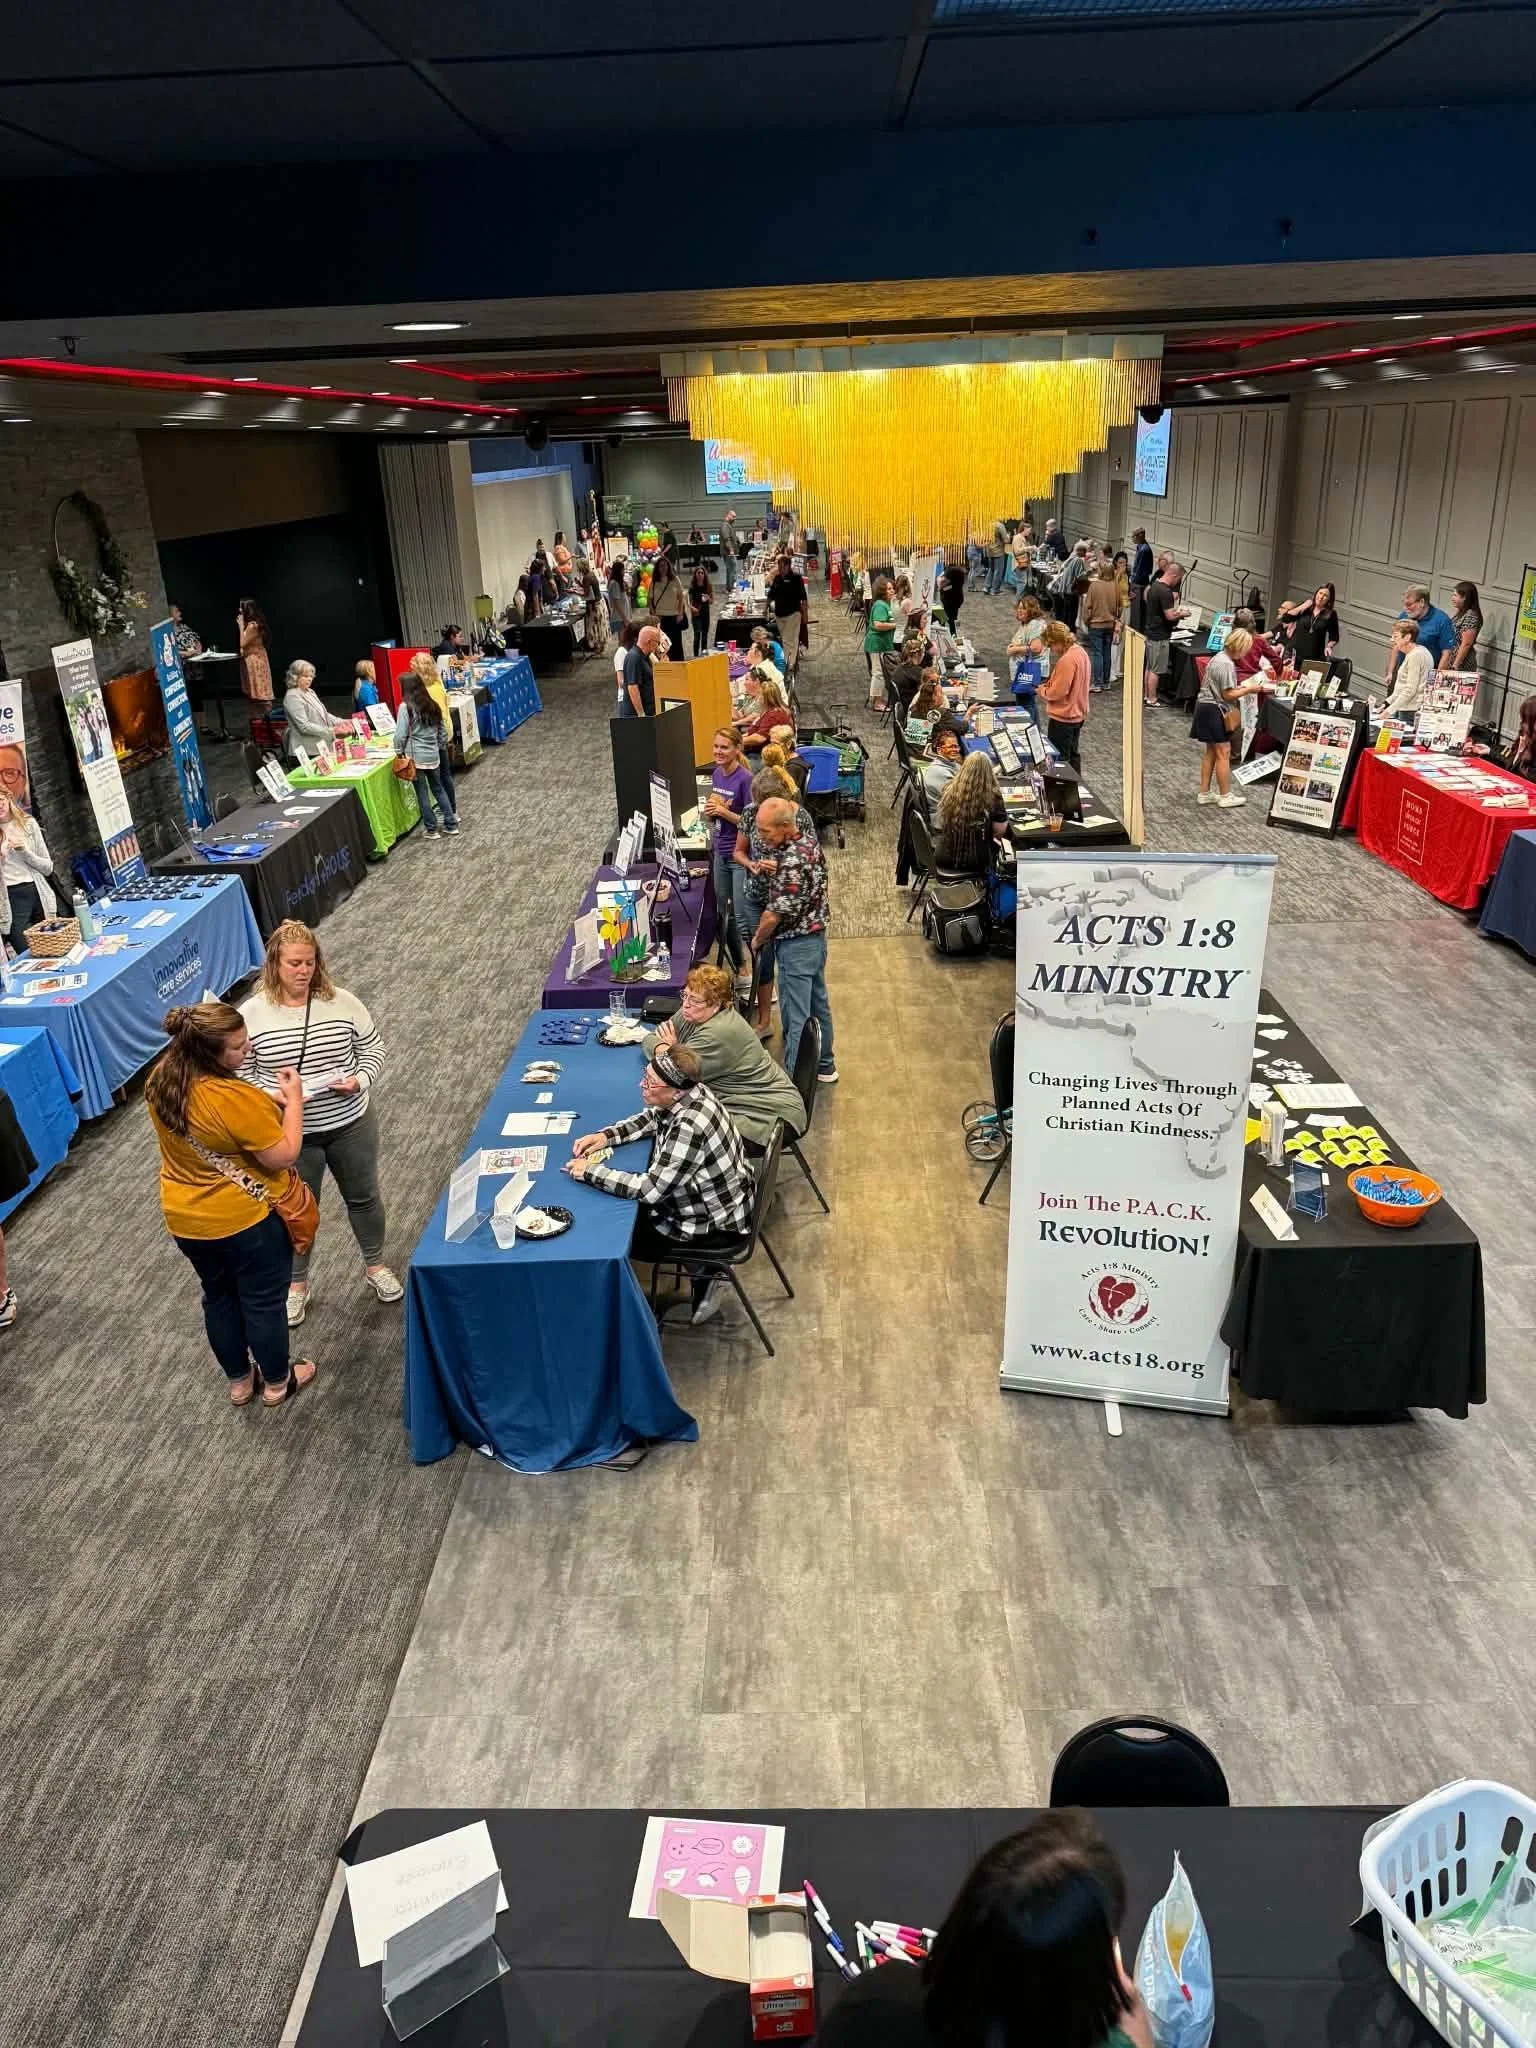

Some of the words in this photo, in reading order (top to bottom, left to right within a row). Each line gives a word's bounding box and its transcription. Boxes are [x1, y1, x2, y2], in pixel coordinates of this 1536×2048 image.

[1054, 914, 1168, 946] ACTS
[1177, 918, 1236, 949] 1:8
[153, 942, 199, 984] innovative
[158, 979, 175, 999] care
[175, 957, 202, 985] services
[1028, 963, 1244, 999] MINISTRY
[1028, 1071, 1110, 1092] Changing
[1114, 1076, 1158, 1092] Lives
[1165, 1079, 1238, 1100] Through
[1061, 1095, 1130, 1112] Planned
[1136, 1099, 1173, 1115] Acts
[1178, 1102, 1203, 1117] Of
[1045, 1115, 1124, 1132] Christian
[1130, 1120, 1214, 1140] Kindness.
[1038, 1192, 1078, 1210] Join
[1084, 1195, 1121, 1212] The
[1127, 1198, 1212, 1222] P.A.C.K.
[1081, 1266, 1101, 1280] Acts
[1103, 1262, 1118, 1270] 1:8
[1122, 1263, 1160, 1289] Ministry
[1129, 1315, 1158, 1335] Connect
[1030, 1343, 1206, 1379] www.acts18.org
